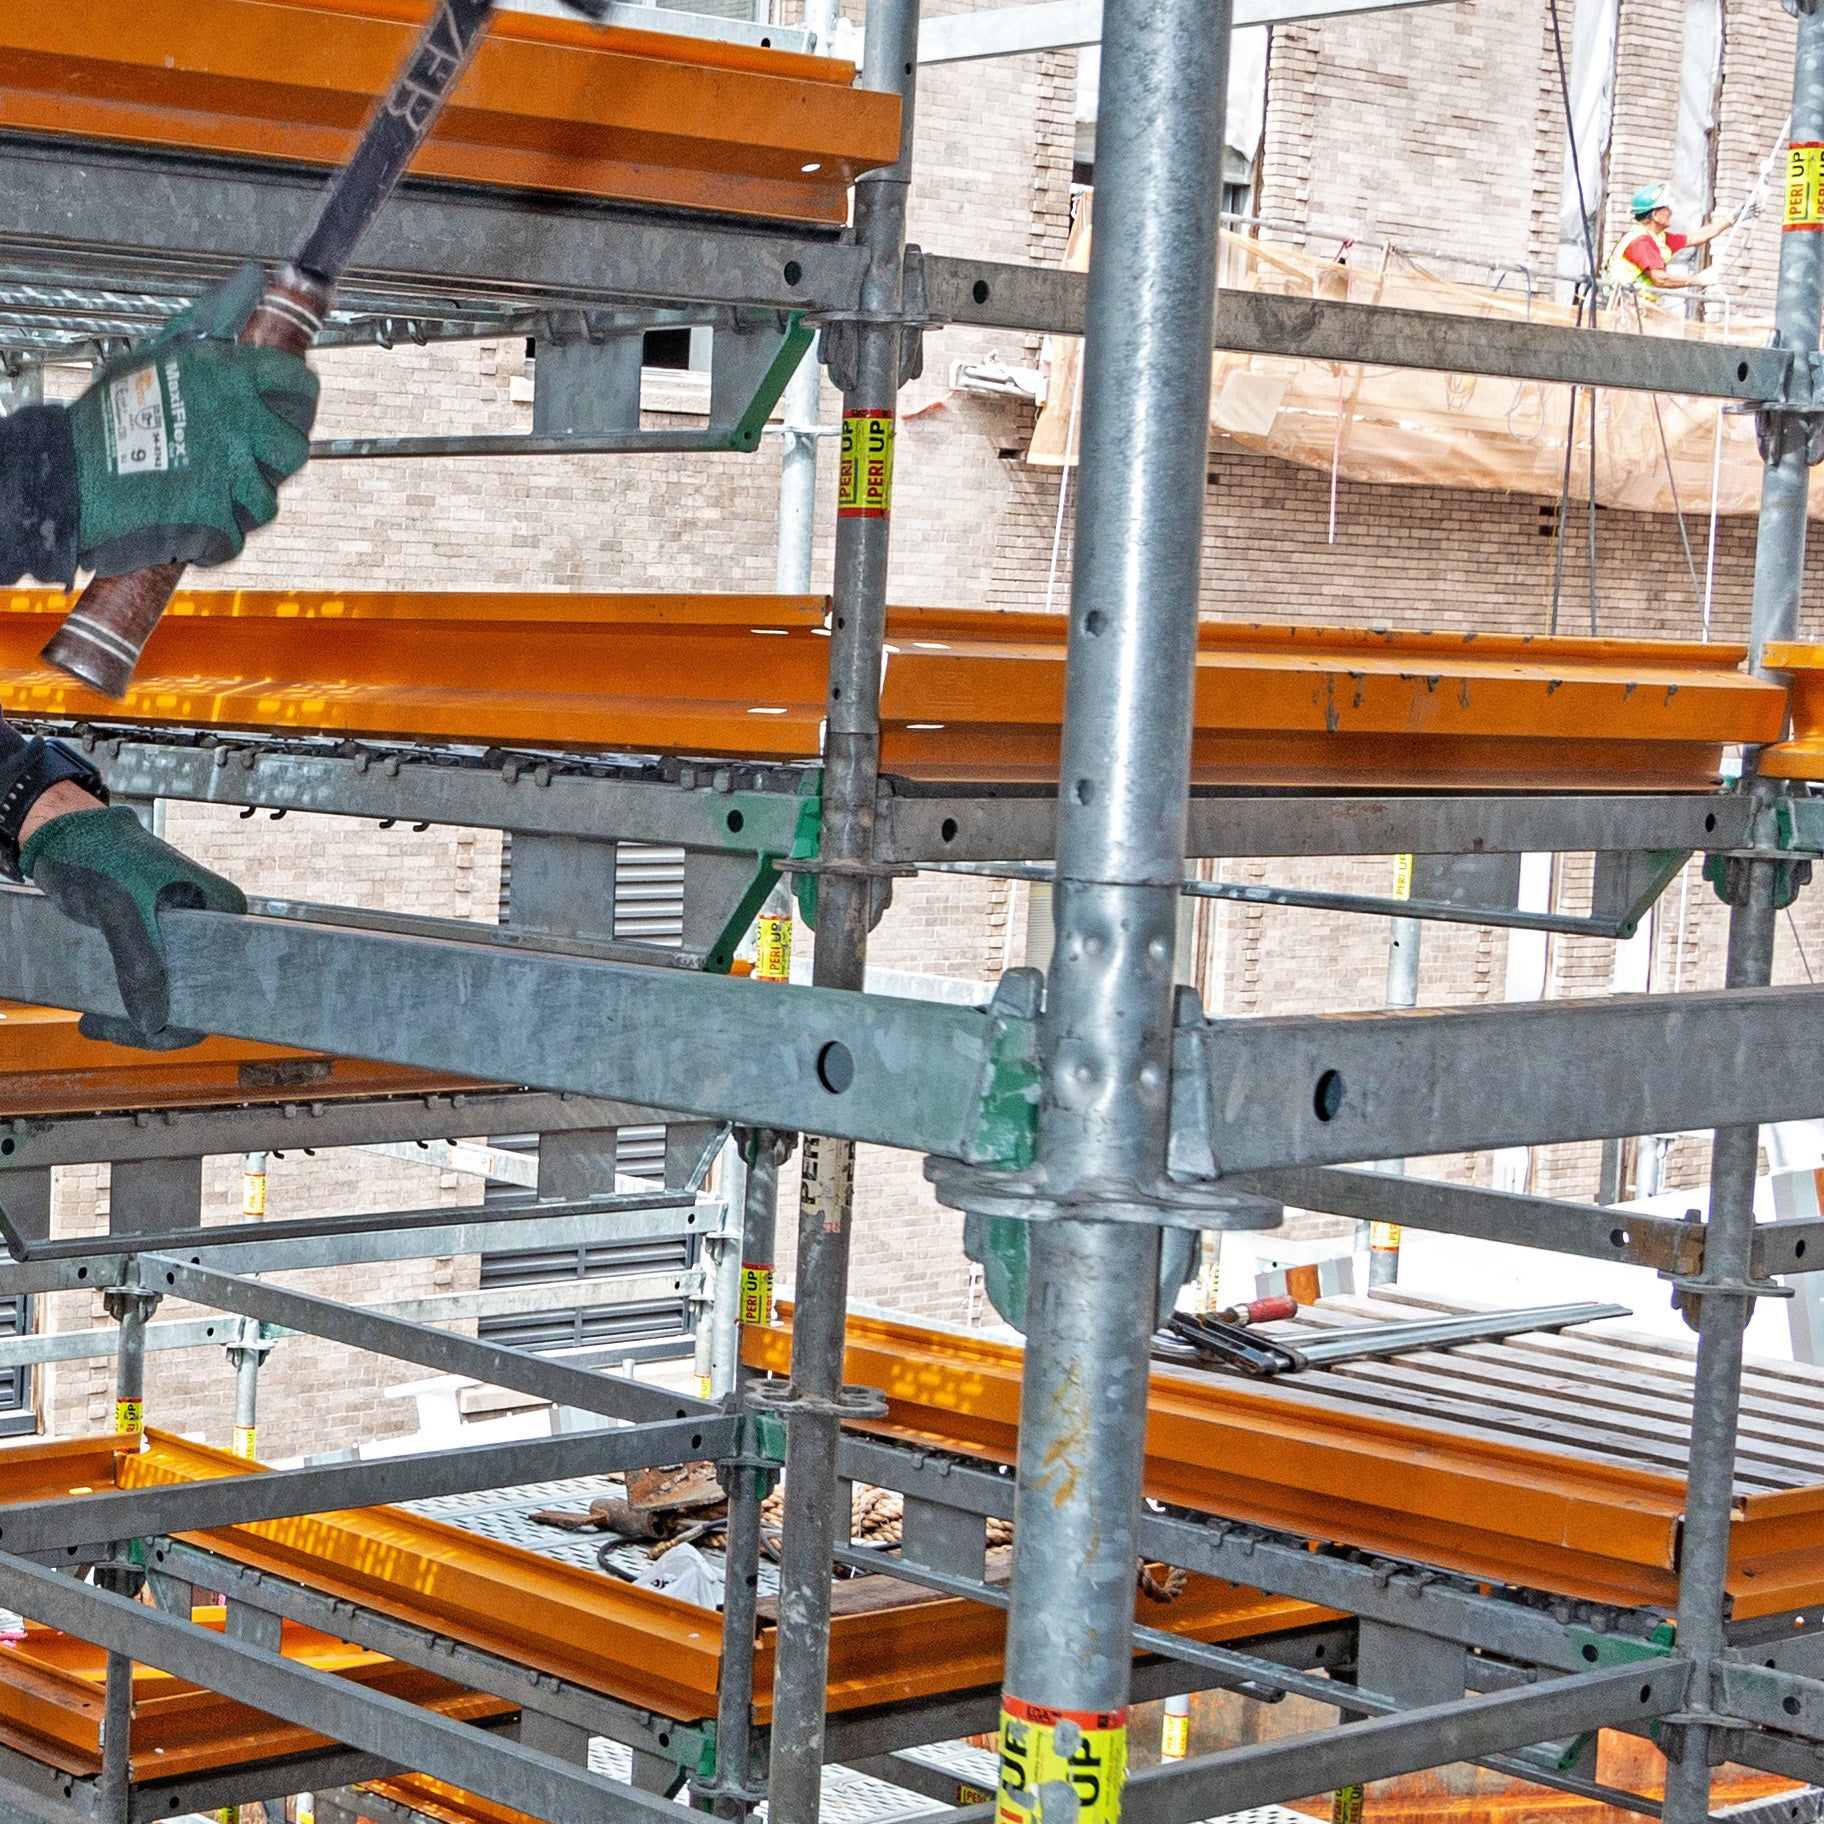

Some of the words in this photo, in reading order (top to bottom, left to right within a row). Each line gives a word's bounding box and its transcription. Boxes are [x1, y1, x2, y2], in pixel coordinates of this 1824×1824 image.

[1791, 151, 1805, 178] UP
[1789, 183, 1803, 215] PERI
[842, 420, 854, 451] UP
[868, 420, 885, 452] UP
[131, 449, 146, 462] 9
[839, 458, 852, 498] PERI
[866, 458, 883, 498] PERI
[771, 922, 782, 943] UP
[769, 946, 781, 971] PERI
[800, 1135, 820, 1205] PER
[747, 1271, 758, 1291] UP
[746, 1295, 757, 1319] PERI
[1068, 1738, 1101, 1808] UP
